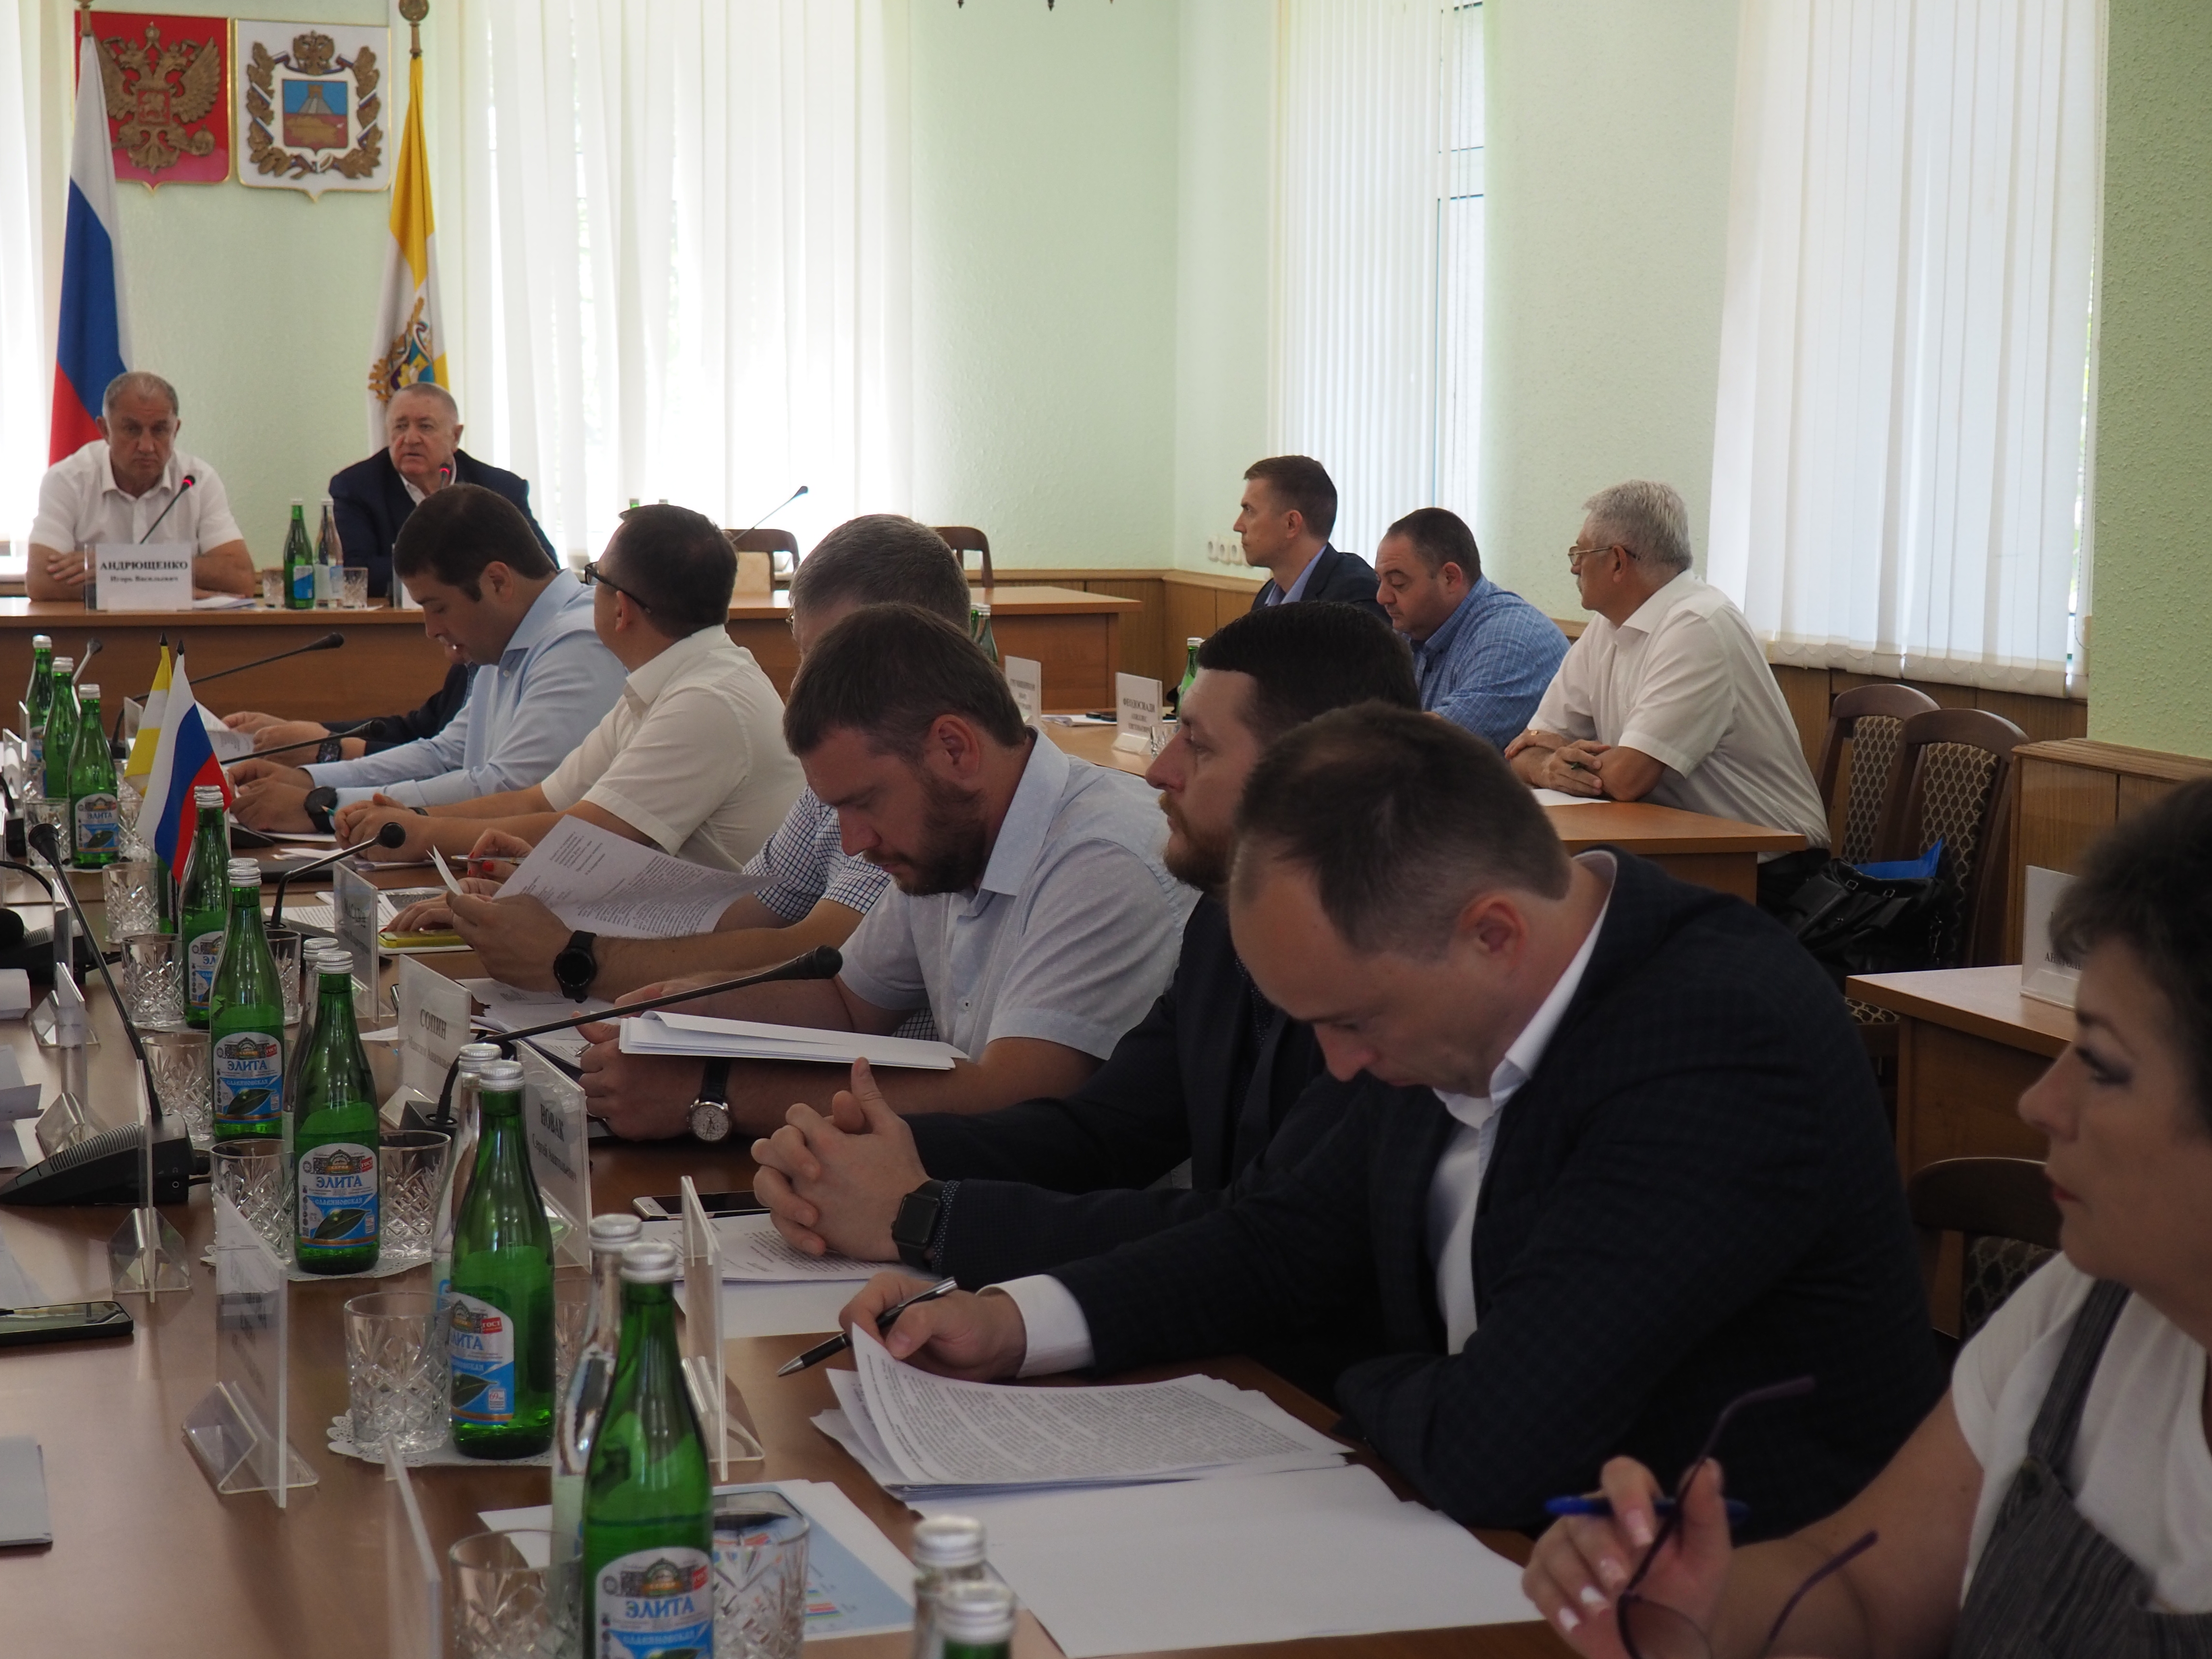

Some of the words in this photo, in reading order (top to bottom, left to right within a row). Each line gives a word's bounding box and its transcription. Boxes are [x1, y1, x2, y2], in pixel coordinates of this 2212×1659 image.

[100, 560, 188, 570] АНДРЮЩЕНКО
[421, 1009, 446, 1040] СОПИН
[228, 1060, 268, 1071] ЭЛИТА
[541, 1104, 564, 1142] НОВАК
[316, 1175, 363, 1189] ЭЛИТА
[625, 1595, 695, 1619] ЭЛИТА
